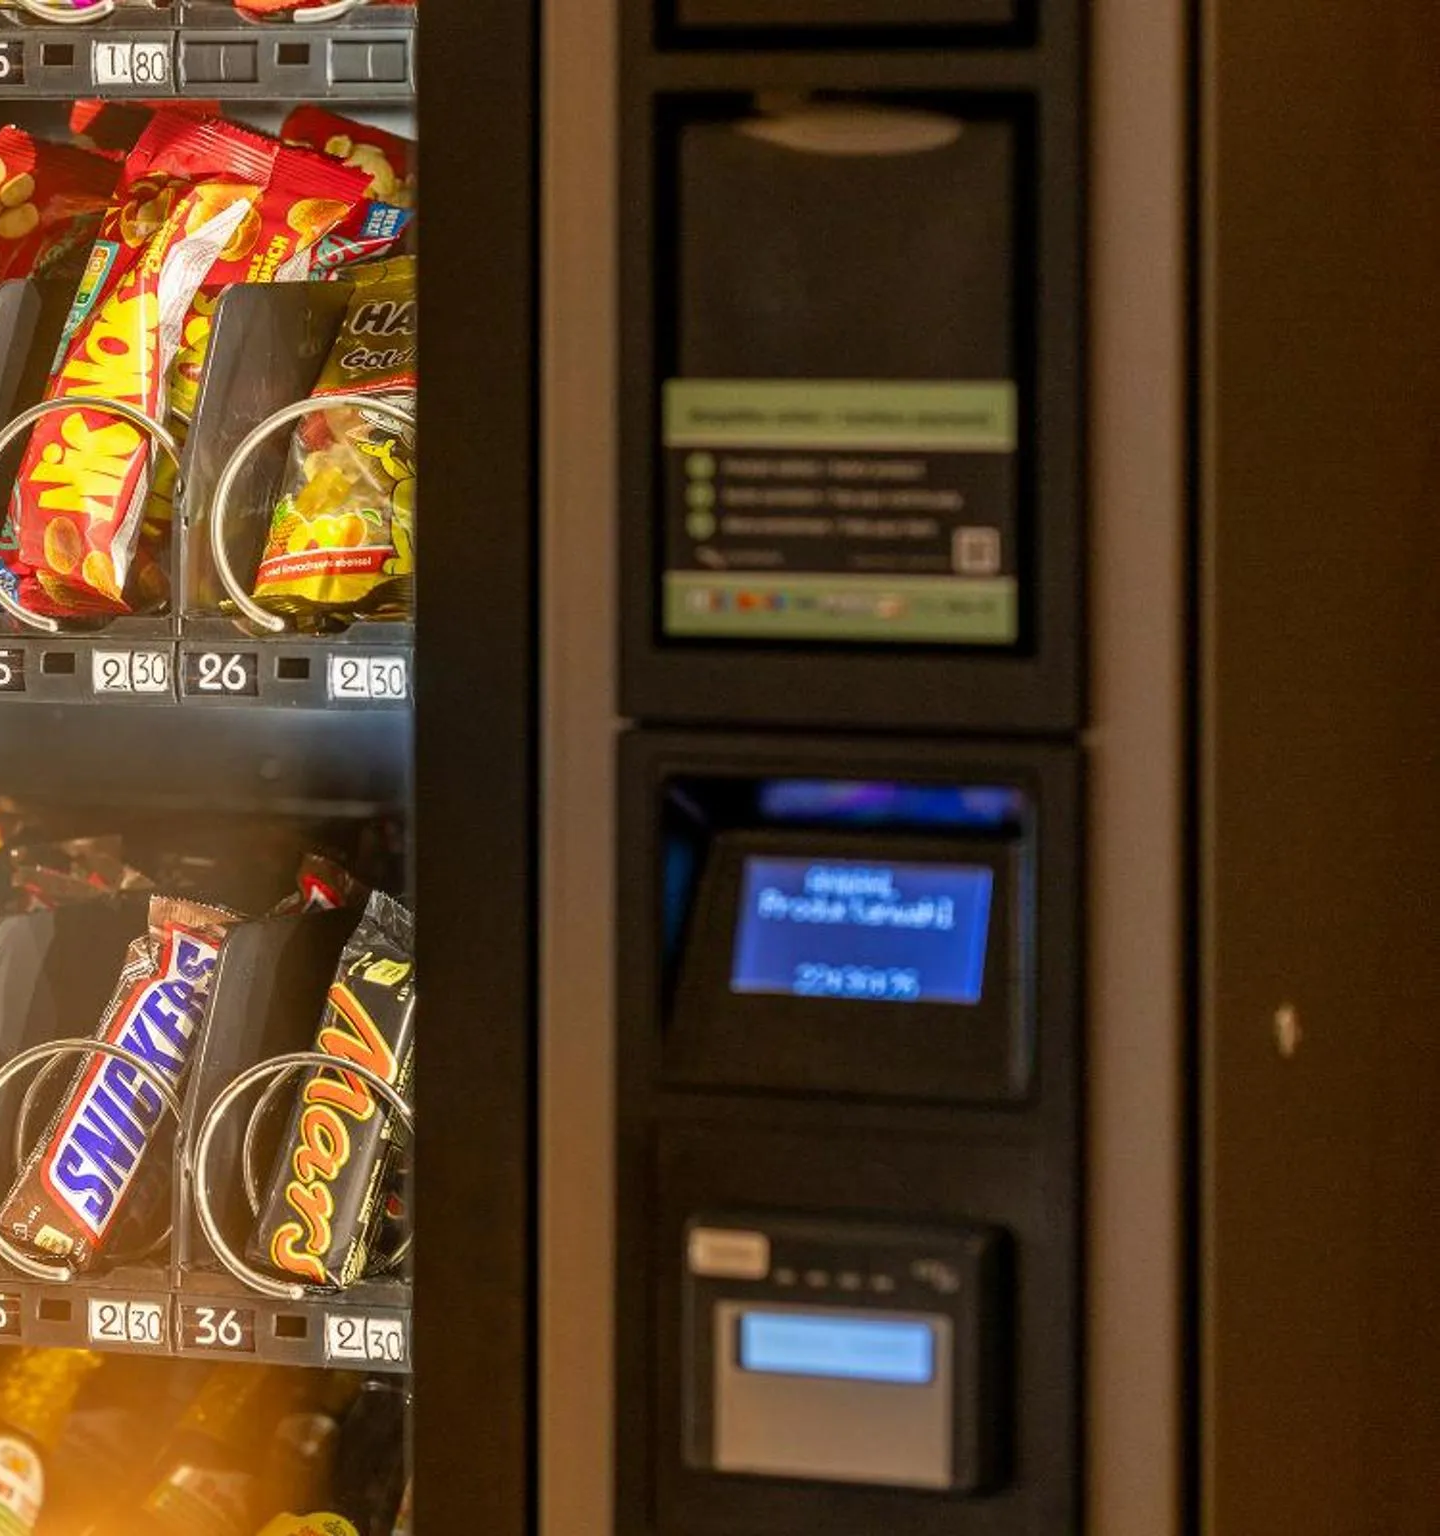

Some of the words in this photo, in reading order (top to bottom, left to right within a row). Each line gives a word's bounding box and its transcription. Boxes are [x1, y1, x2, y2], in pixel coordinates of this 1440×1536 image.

[106, 45, 166, 82] 1.80
[198, 652, 247, 691] 26
[56, 940, 216, 1221] SNICKERS
[271, 982, 398, 1284] Mars
[195, 1306, 243, 1347] 36
